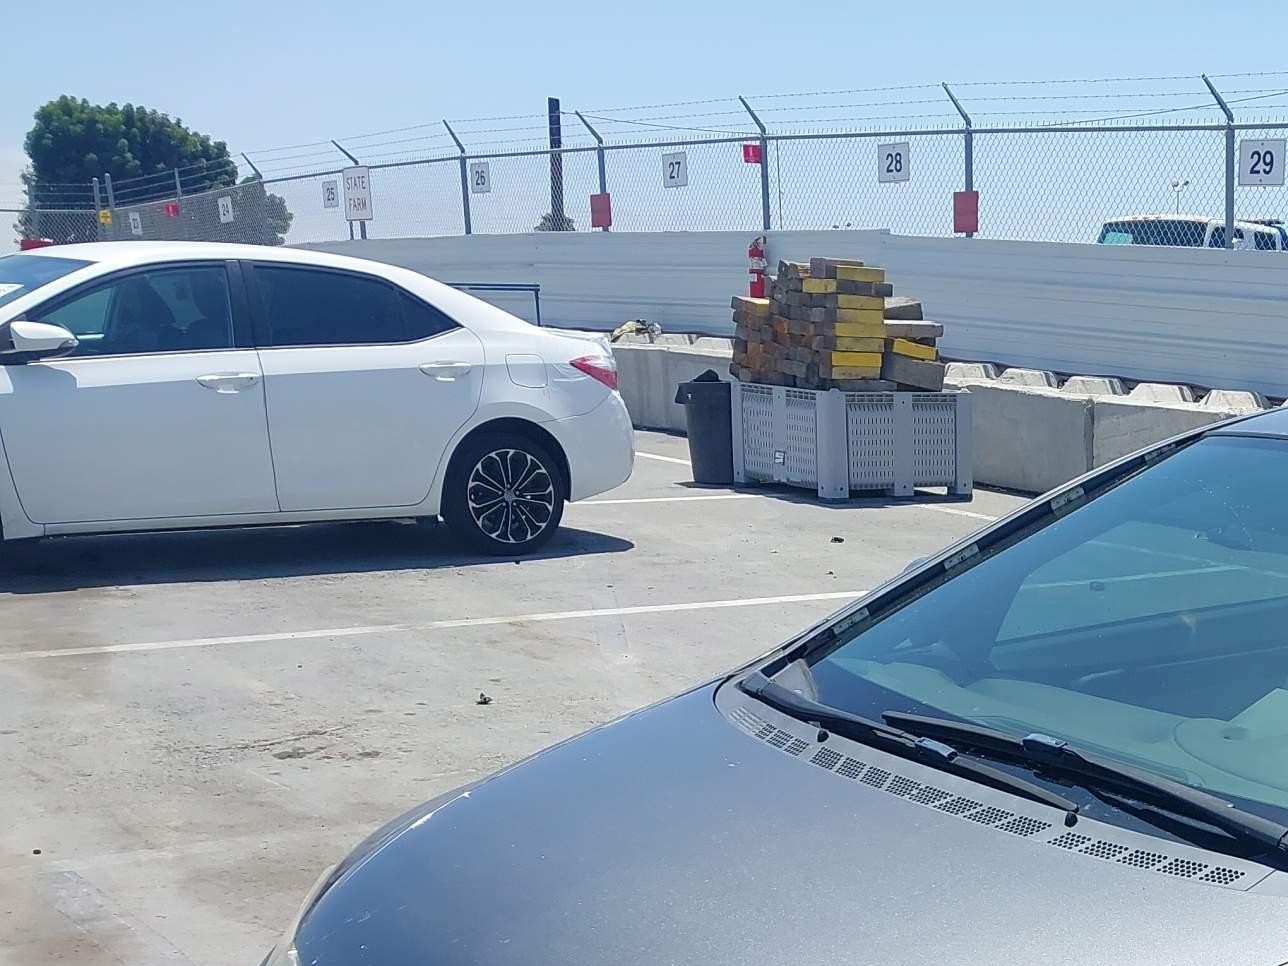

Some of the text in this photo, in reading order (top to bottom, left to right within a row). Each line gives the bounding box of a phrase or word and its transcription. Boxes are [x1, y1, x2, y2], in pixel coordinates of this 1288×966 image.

[885, 152, 903, 174] 28
[1250, 150, 1274, 175] 29
[475, 170, 486, 186] 26
[668, 161, 682, 180] 27
[346, 175, 366, 190] STATE
[326, 187, 335, 201] 25
[222, 203, 230, 217] 24
[348, 198, 368, 212] FARM
